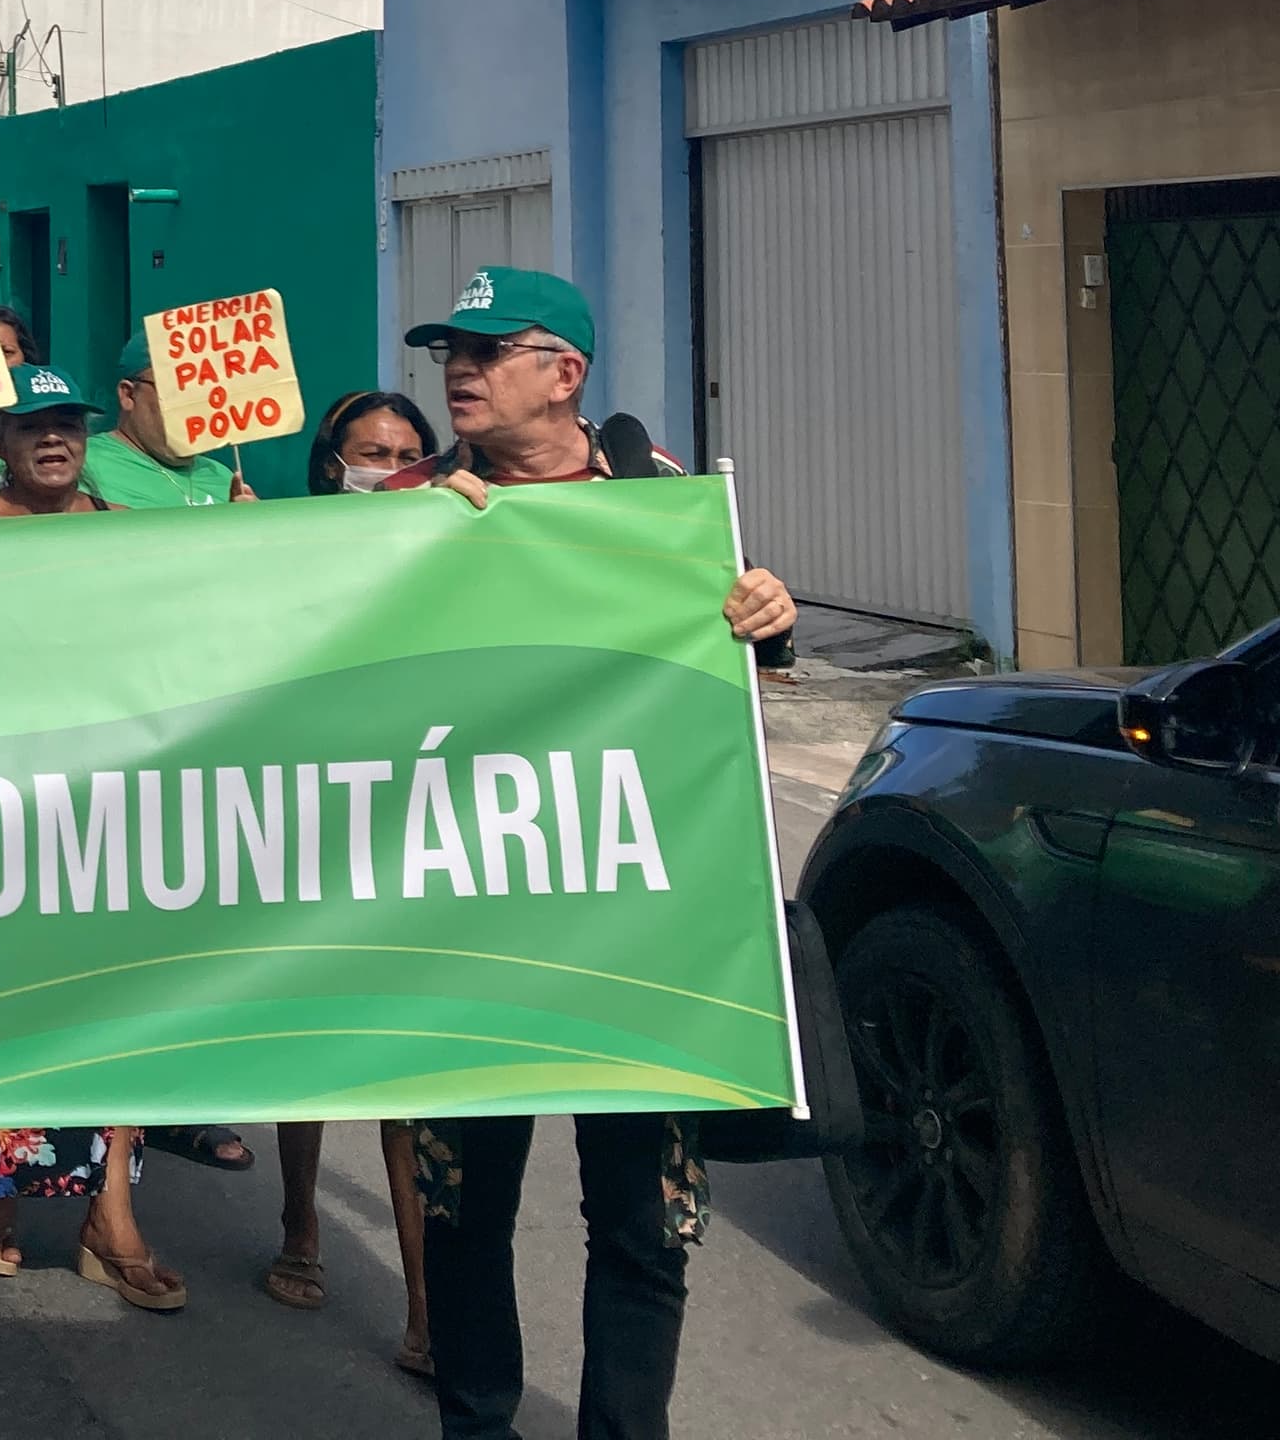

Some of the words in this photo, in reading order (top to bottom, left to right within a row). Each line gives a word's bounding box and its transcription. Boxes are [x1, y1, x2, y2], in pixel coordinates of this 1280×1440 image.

[162, 292, 273, 331] ENERGIA
[461, 287, 494, 298] ALMA
[169, 313, 276, 359] SOLAR
[175, 345, 280, 391] PARA
[208, 386, 227, 409] O
[186, 397, 282, 445] POVO
